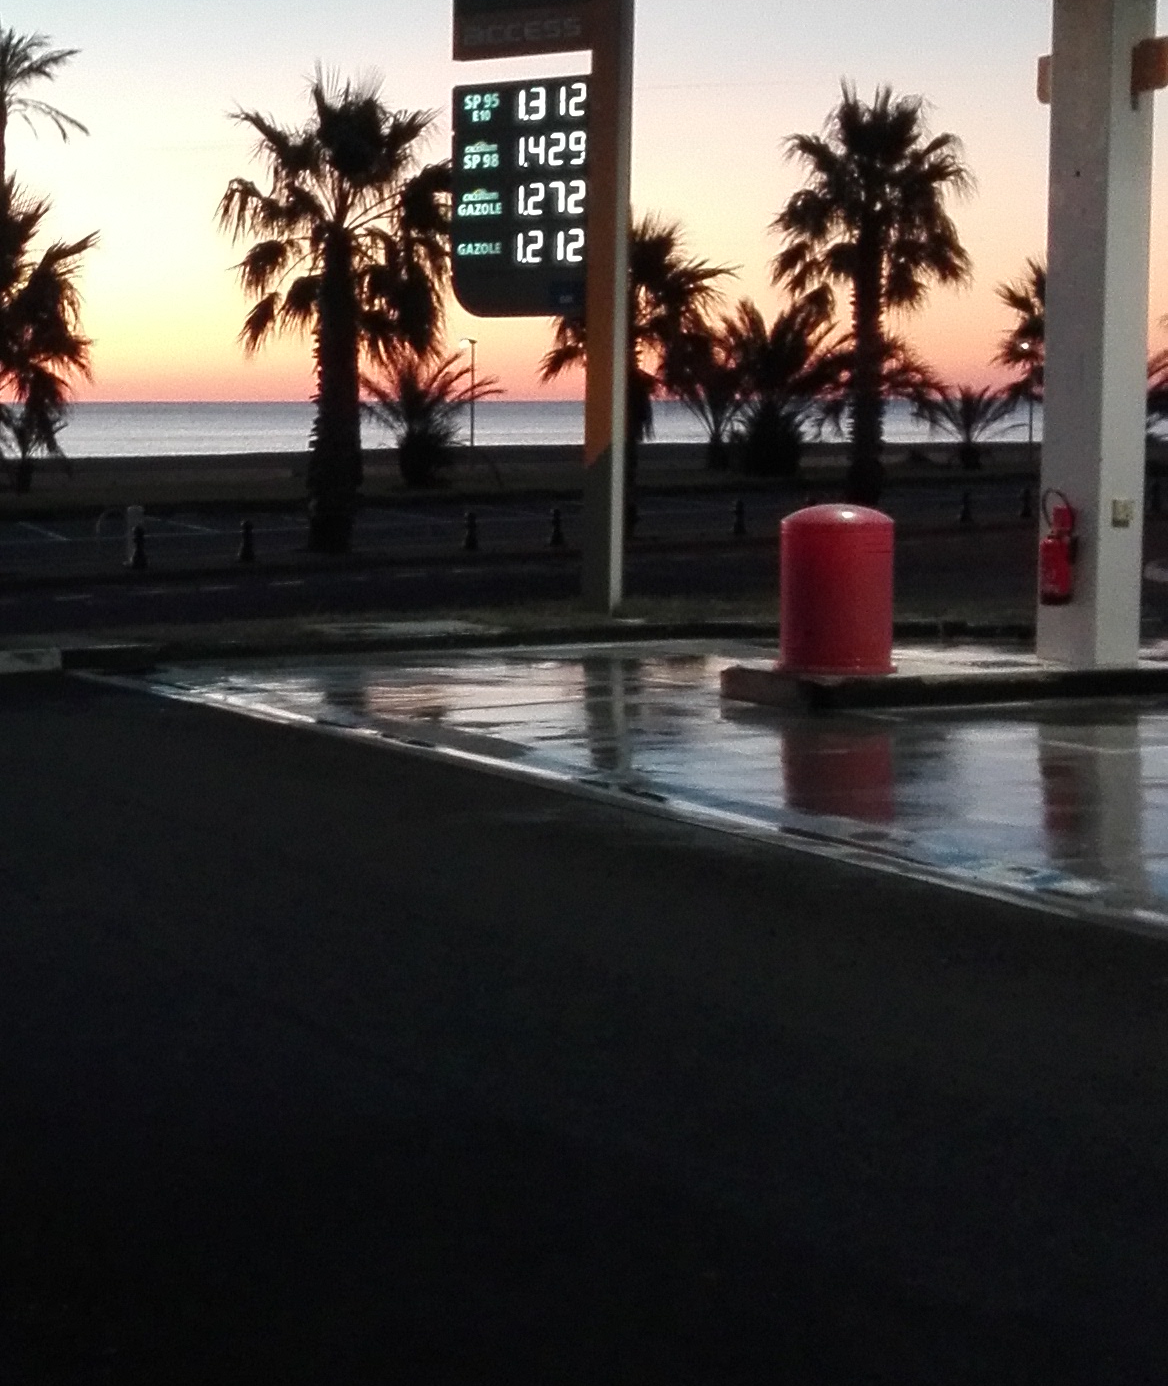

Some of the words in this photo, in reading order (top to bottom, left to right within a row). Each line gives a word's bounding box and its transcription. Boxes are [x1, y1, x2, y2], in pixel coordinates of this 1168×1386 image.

[464, 95, 481, 111] SP
[483, 93, 500, 108] 95
[463, 155, 481, 169] SP
[483, 154, 500, 168] 98
[518, 131, 587, 167] 1.429
[457, 203, 502, 217] GAZOLE
[518, 180, 586, 216] 1.272
[457, 242, 502, 256] GAZOLE
